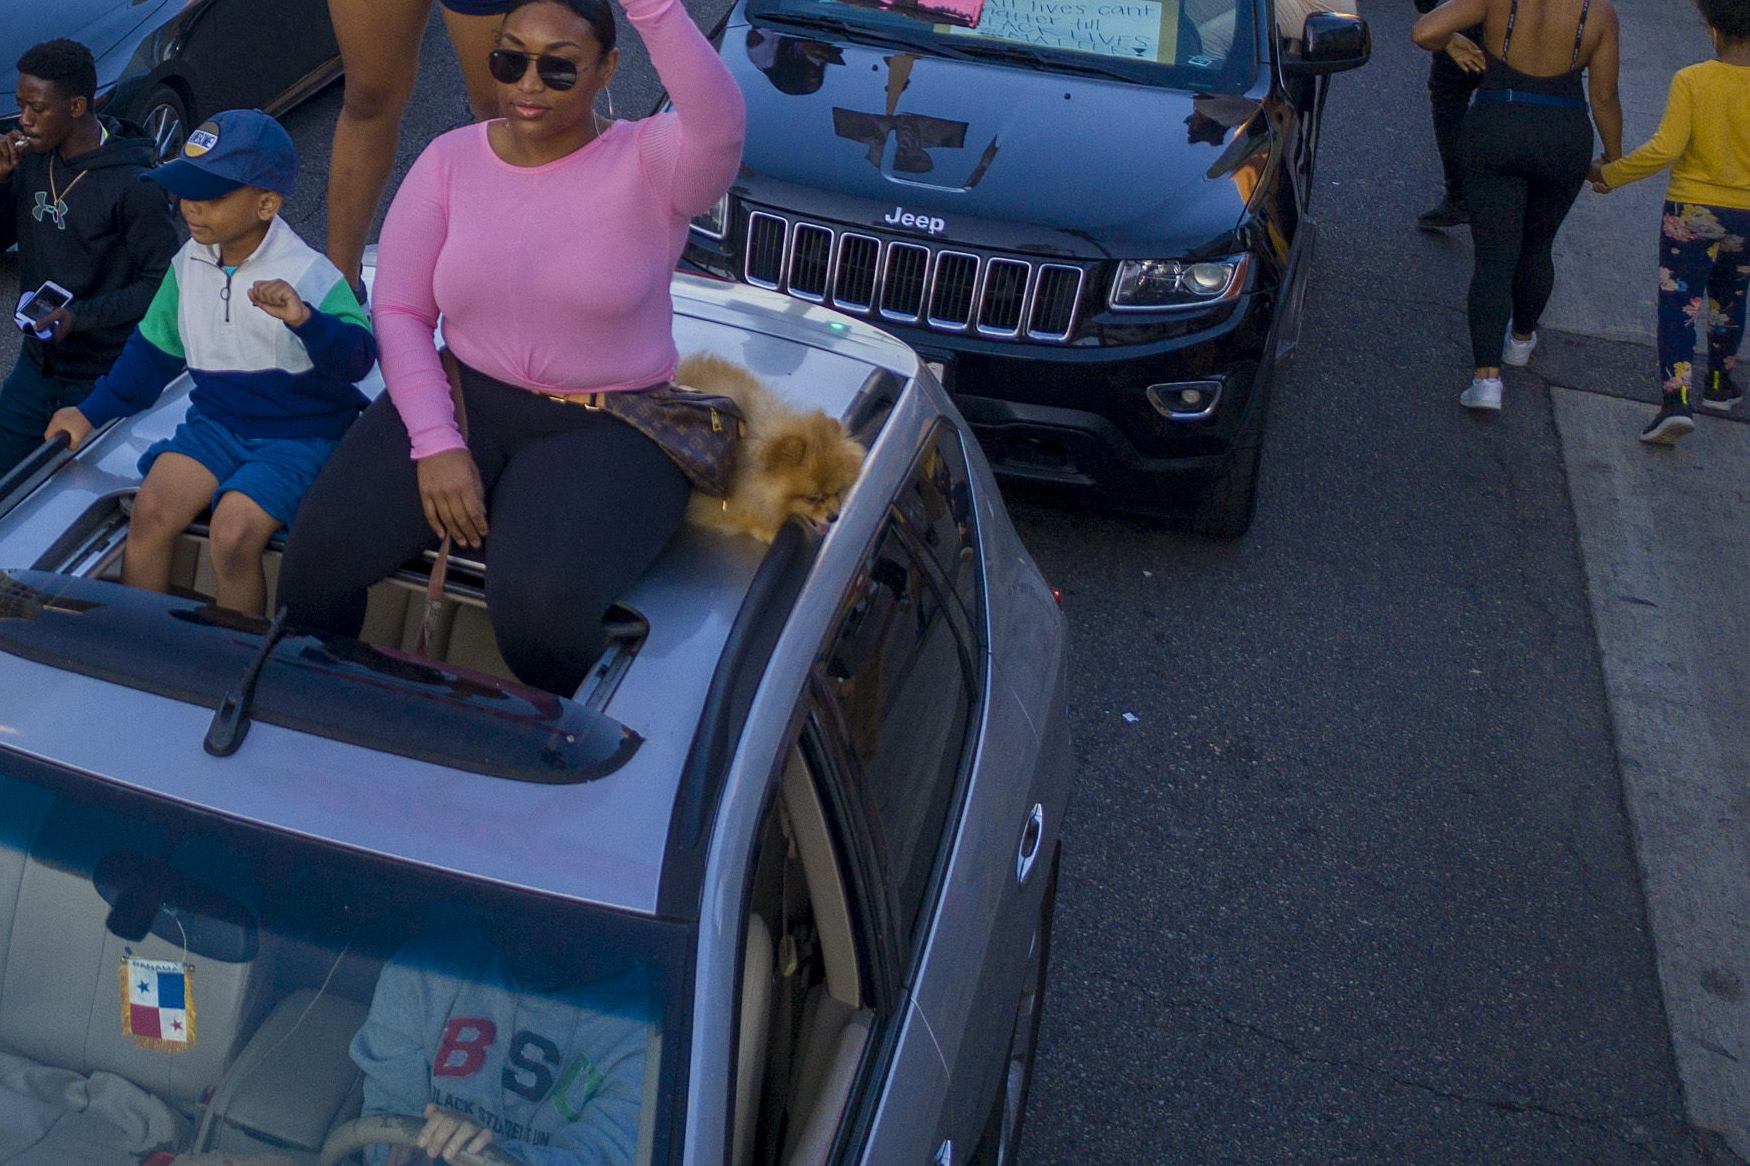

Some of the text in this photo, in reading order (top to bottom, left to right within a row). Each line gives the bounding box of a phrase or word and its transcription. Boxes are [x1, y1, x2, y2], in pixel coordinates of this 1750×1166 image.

[1070, 17, 1100, 32] till
[884, 206, 946, 232] Jeep
[132, 960, 179, 972] PANAMA
